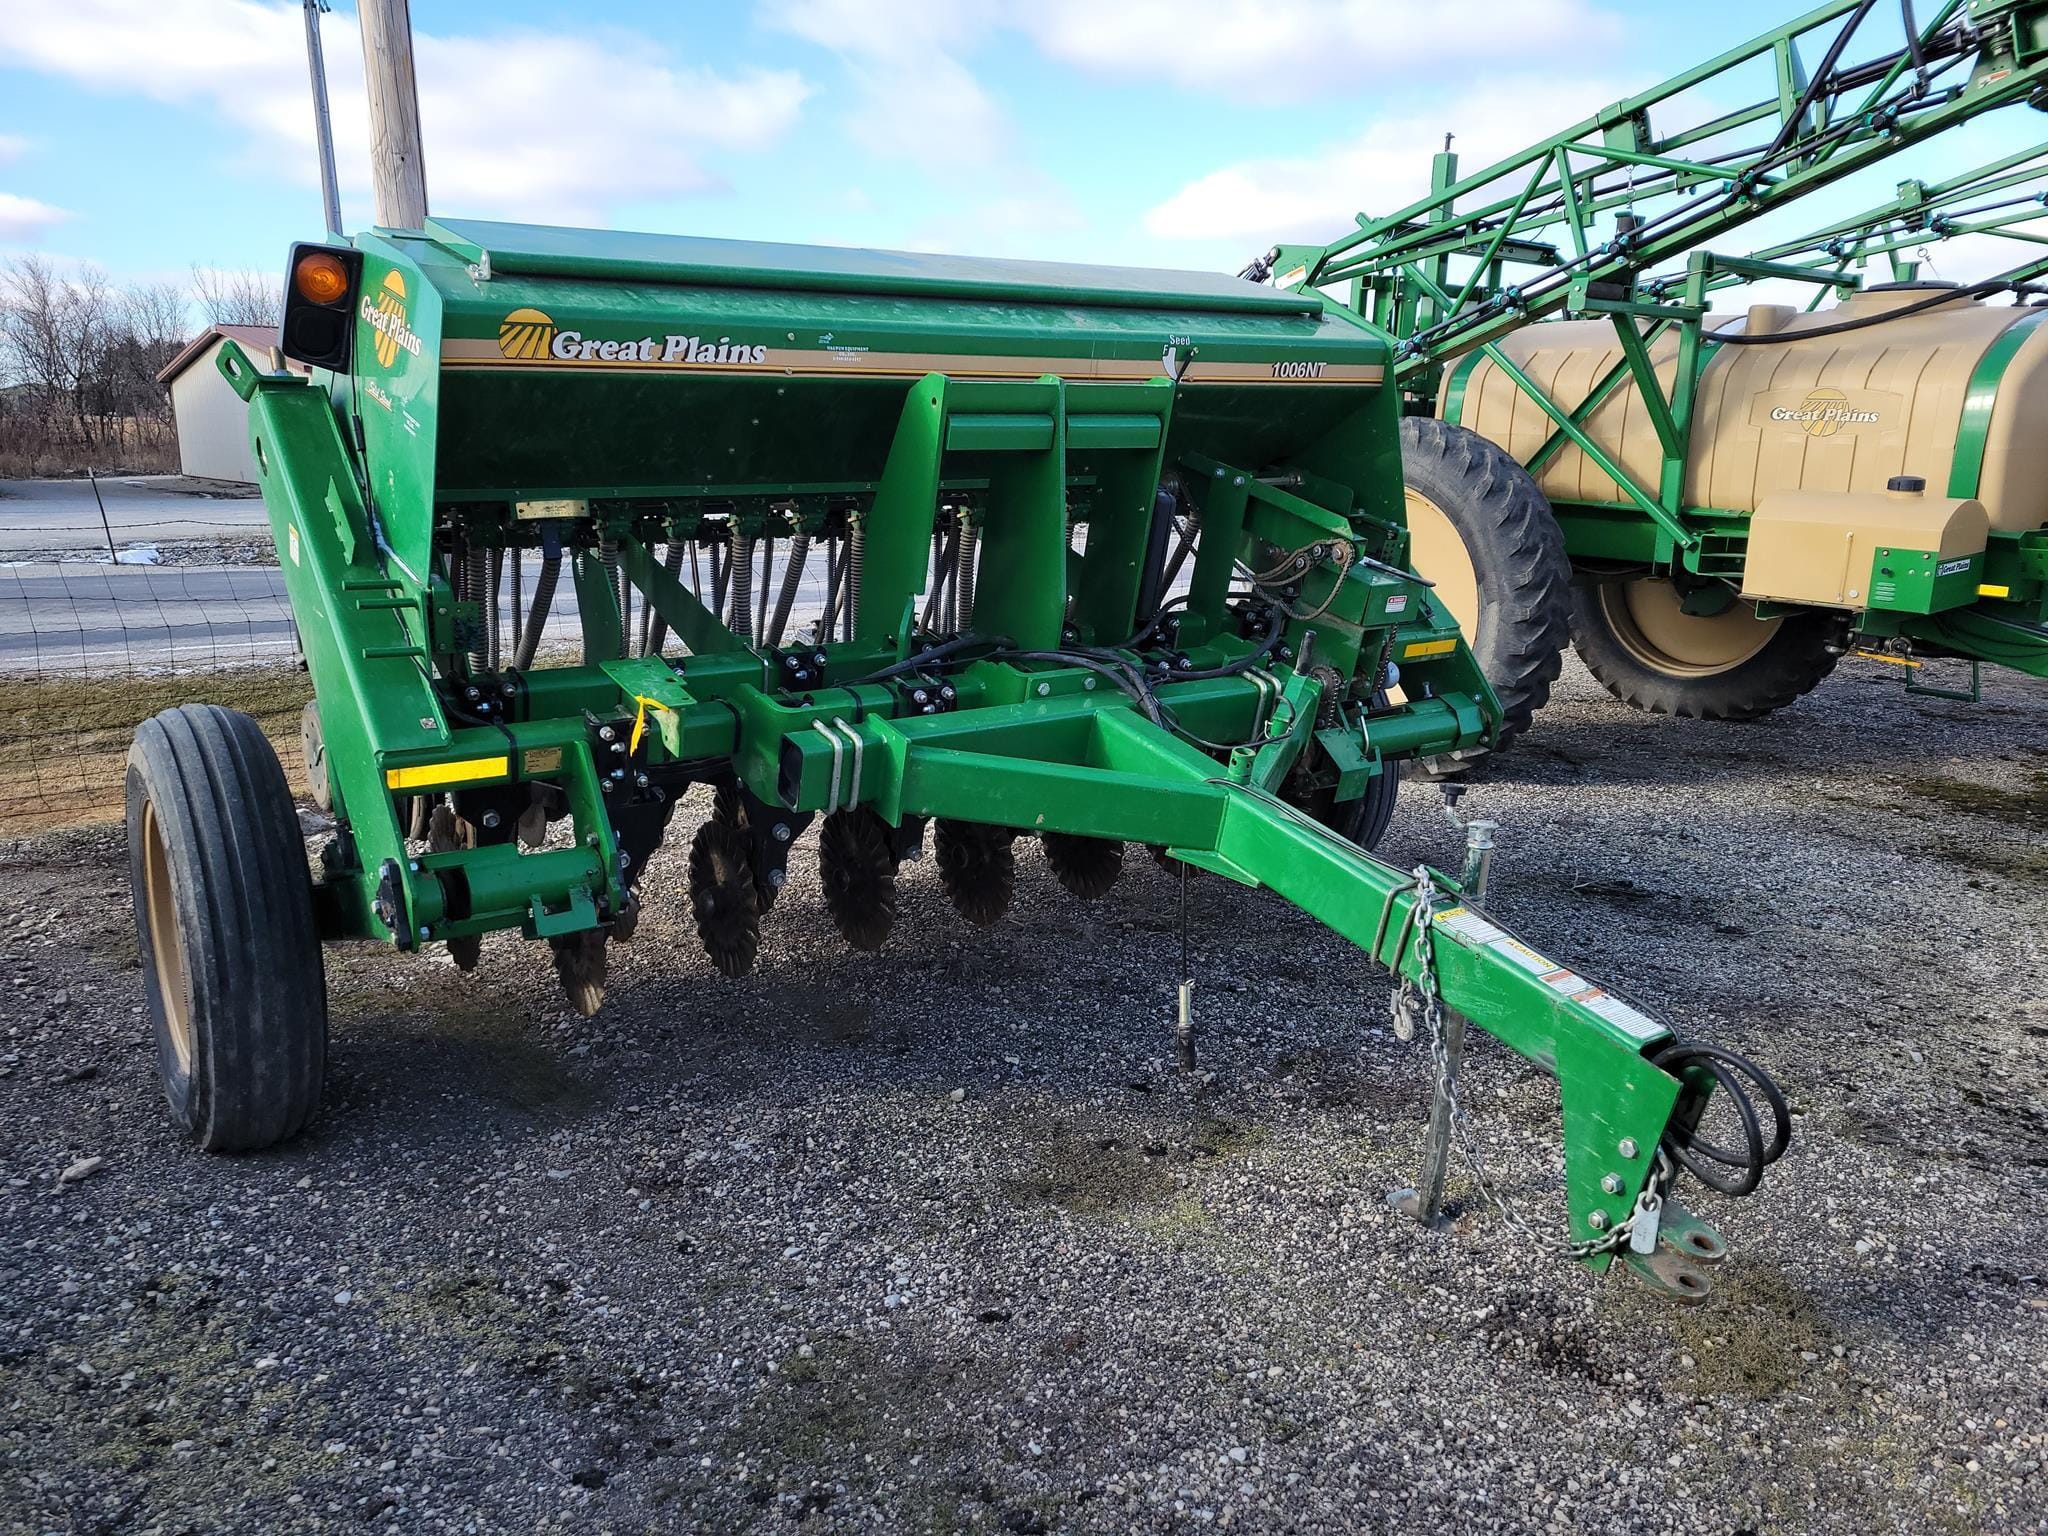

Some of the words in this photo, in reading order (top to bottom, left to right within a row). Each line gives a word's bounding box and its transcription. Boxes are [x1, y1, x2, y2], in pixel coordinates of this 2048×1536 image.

[360, 295, 389, 333] Great
[388, 311, 422, 358] Plains
[552, 331, 656, 362] Great
[658, 335, 768, 364] Plains
[1169, 334, 1191, 346] Seed
[1162, 344, 1169, 356] F
[1272, 362, 1327, 378] 1006NT
[1771, 407, 1821, 422] Great
[1822, 408, 1880, 424] Plains
[1514, 940, 1553, 969] CAUTION
